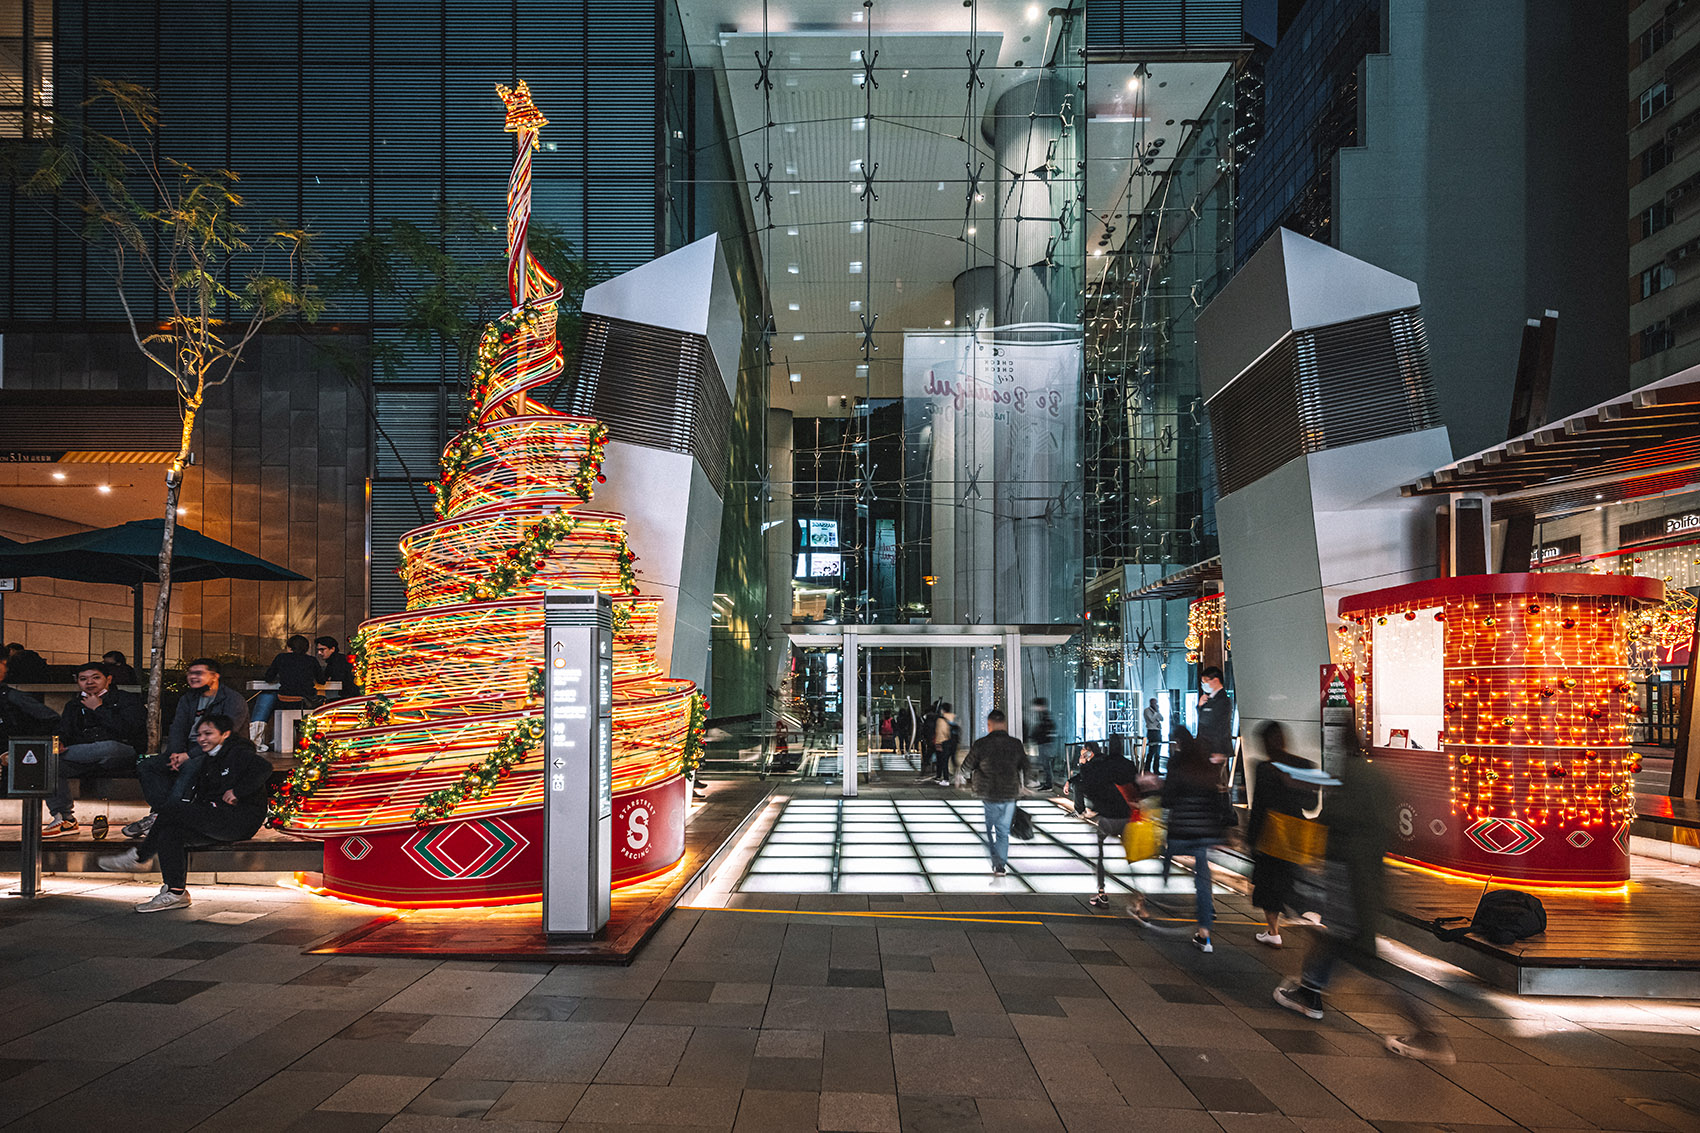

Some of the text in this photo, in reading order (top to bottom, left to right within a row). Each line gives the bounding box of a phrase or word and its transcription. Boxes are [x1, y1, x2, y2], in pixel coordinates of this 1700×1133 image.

[1665, 515, 1700, 532] Polifo
[626, 807, 650, 850] S
[620, 842, 653, 860] PRECINCT
